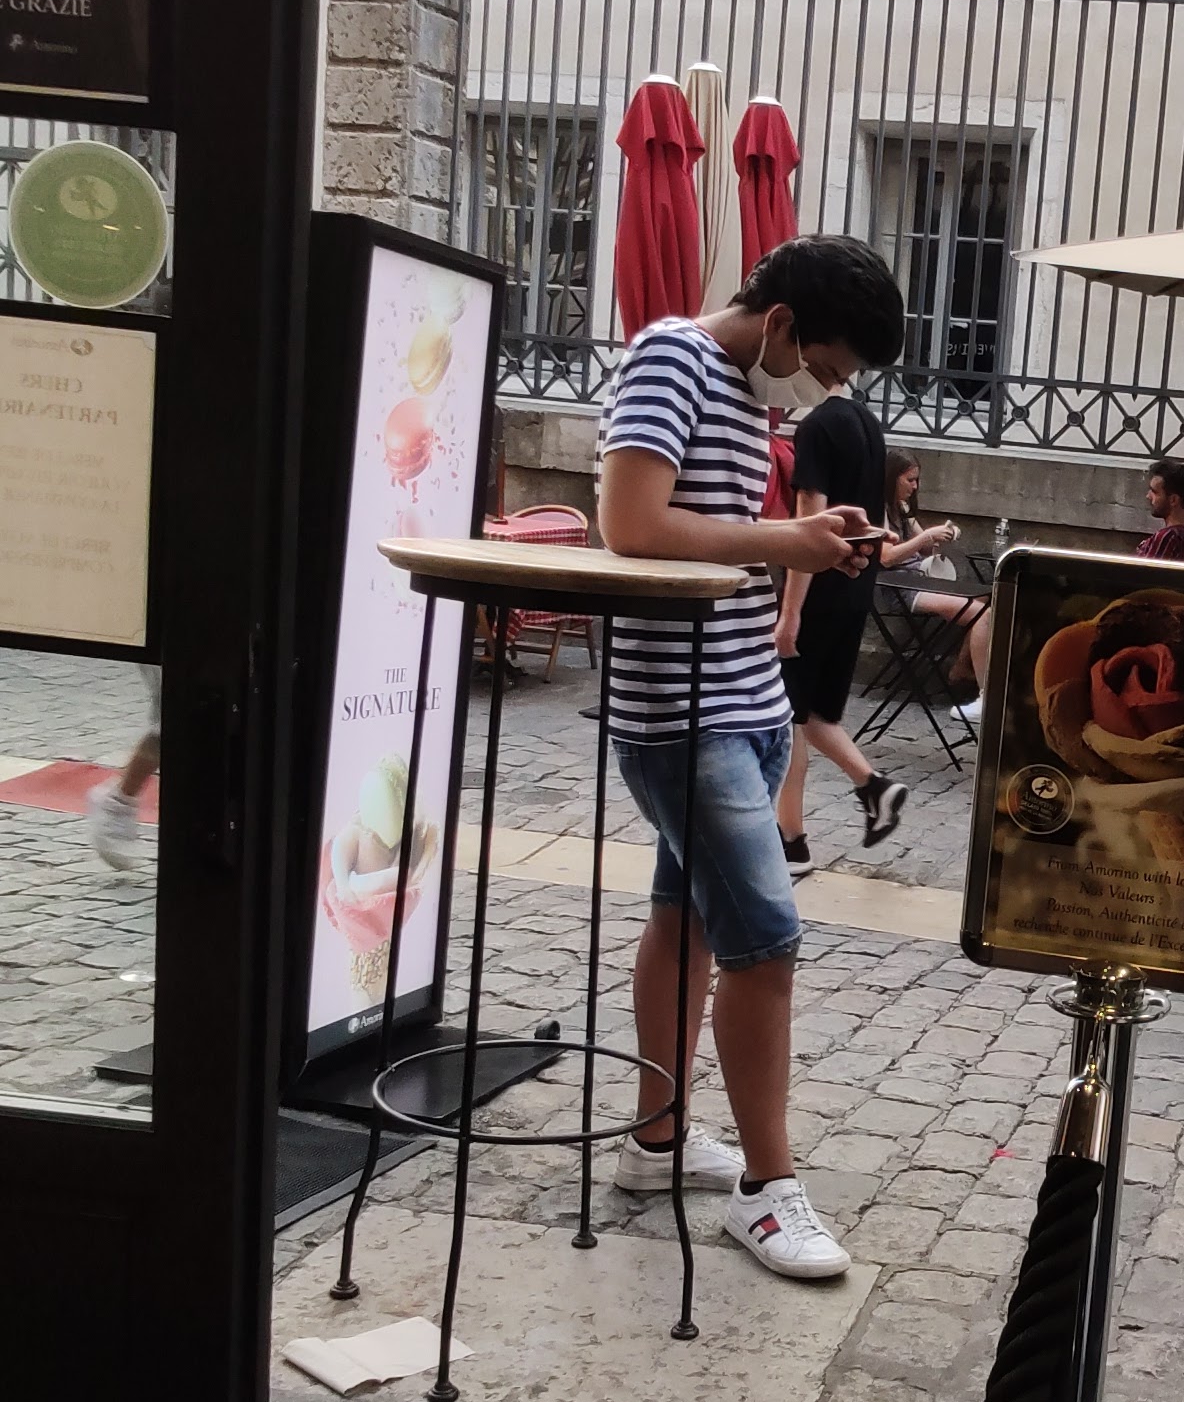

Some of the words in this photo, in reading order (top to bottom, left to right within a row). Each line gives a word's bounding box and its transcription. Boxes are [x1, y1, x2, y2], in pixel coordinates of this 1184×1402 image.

[384, 667, 407, 685] THE
[341, 687, 441, 722] SIGNATUE
[1047, 855, 1079, 873] From
[1084, 860, 1139, 880] Amorino
[1143, 870, 1172, 886] with
[1079, 881, 1104, 897] Nos
[1109, 884, 1155, 905] Valeurs
[1046, 898, 1094, 920] Passion,
[1098, 906, 1178, 928] Authenticité
[1013, 916, 1070, 937] recherche
[1072, 925, 1127, 943] continue
[1130, 931, 1145, 946] de
